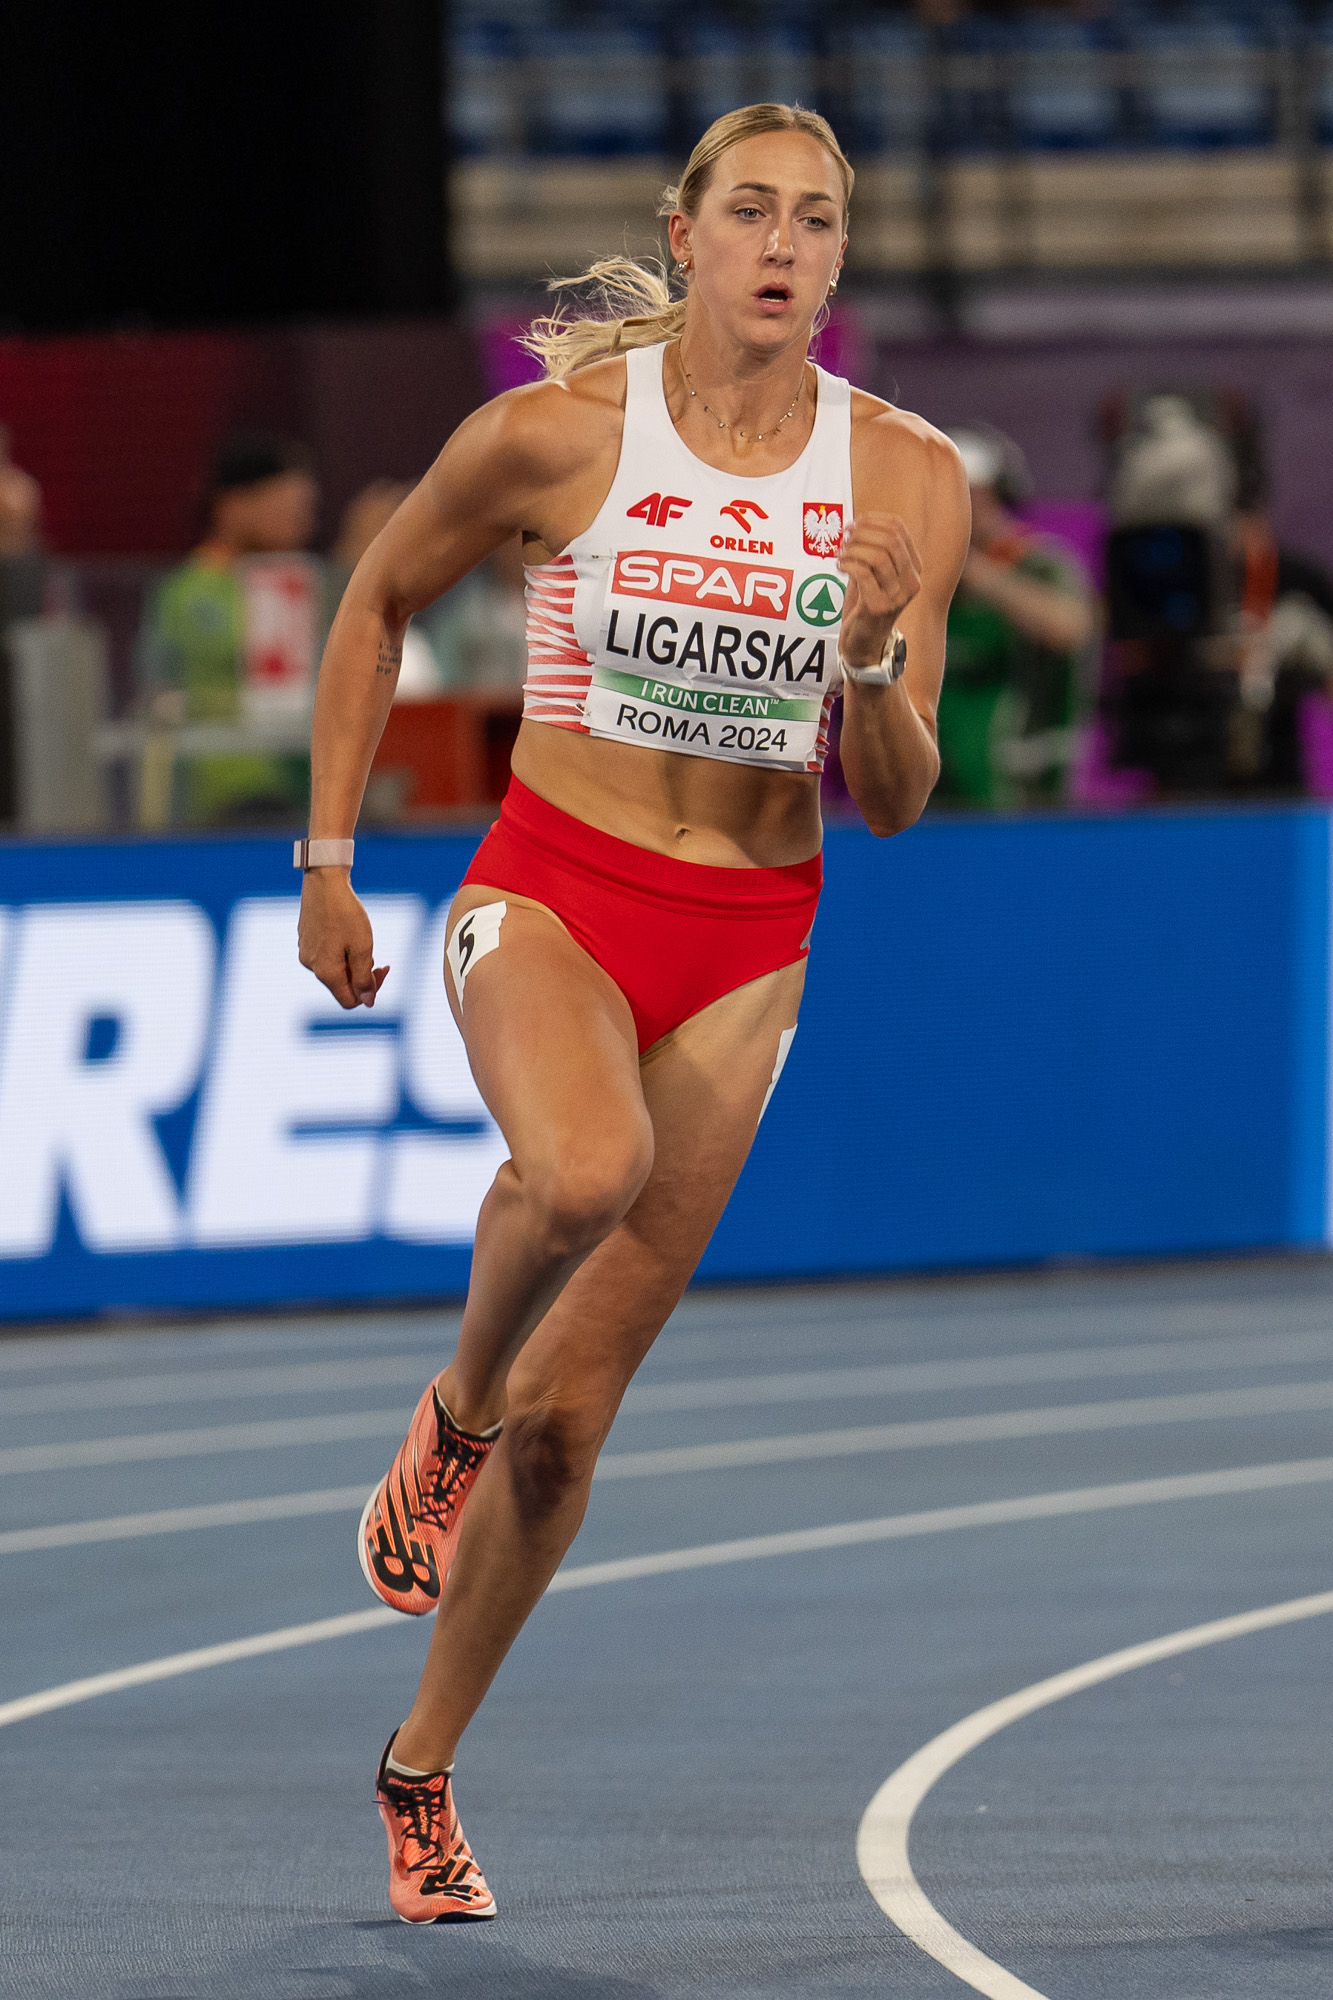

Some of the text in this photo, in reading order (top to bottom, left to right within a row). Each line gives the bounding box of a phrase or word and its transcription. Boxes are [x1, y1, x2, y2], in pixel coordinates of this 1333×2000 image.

[626, 492, 693, 528] 4F
[710, 534, 774, 555] ORLEN
[618, 555, 787, 613] SPAR
[606, 609, 826, 683] LIGARSKA
[640, 680, 649, 697] I
[651, 683, 698, 710] RUN
[616, 703, 788, 752] ROMA 2024
[458, 914, 475, 978] 5
